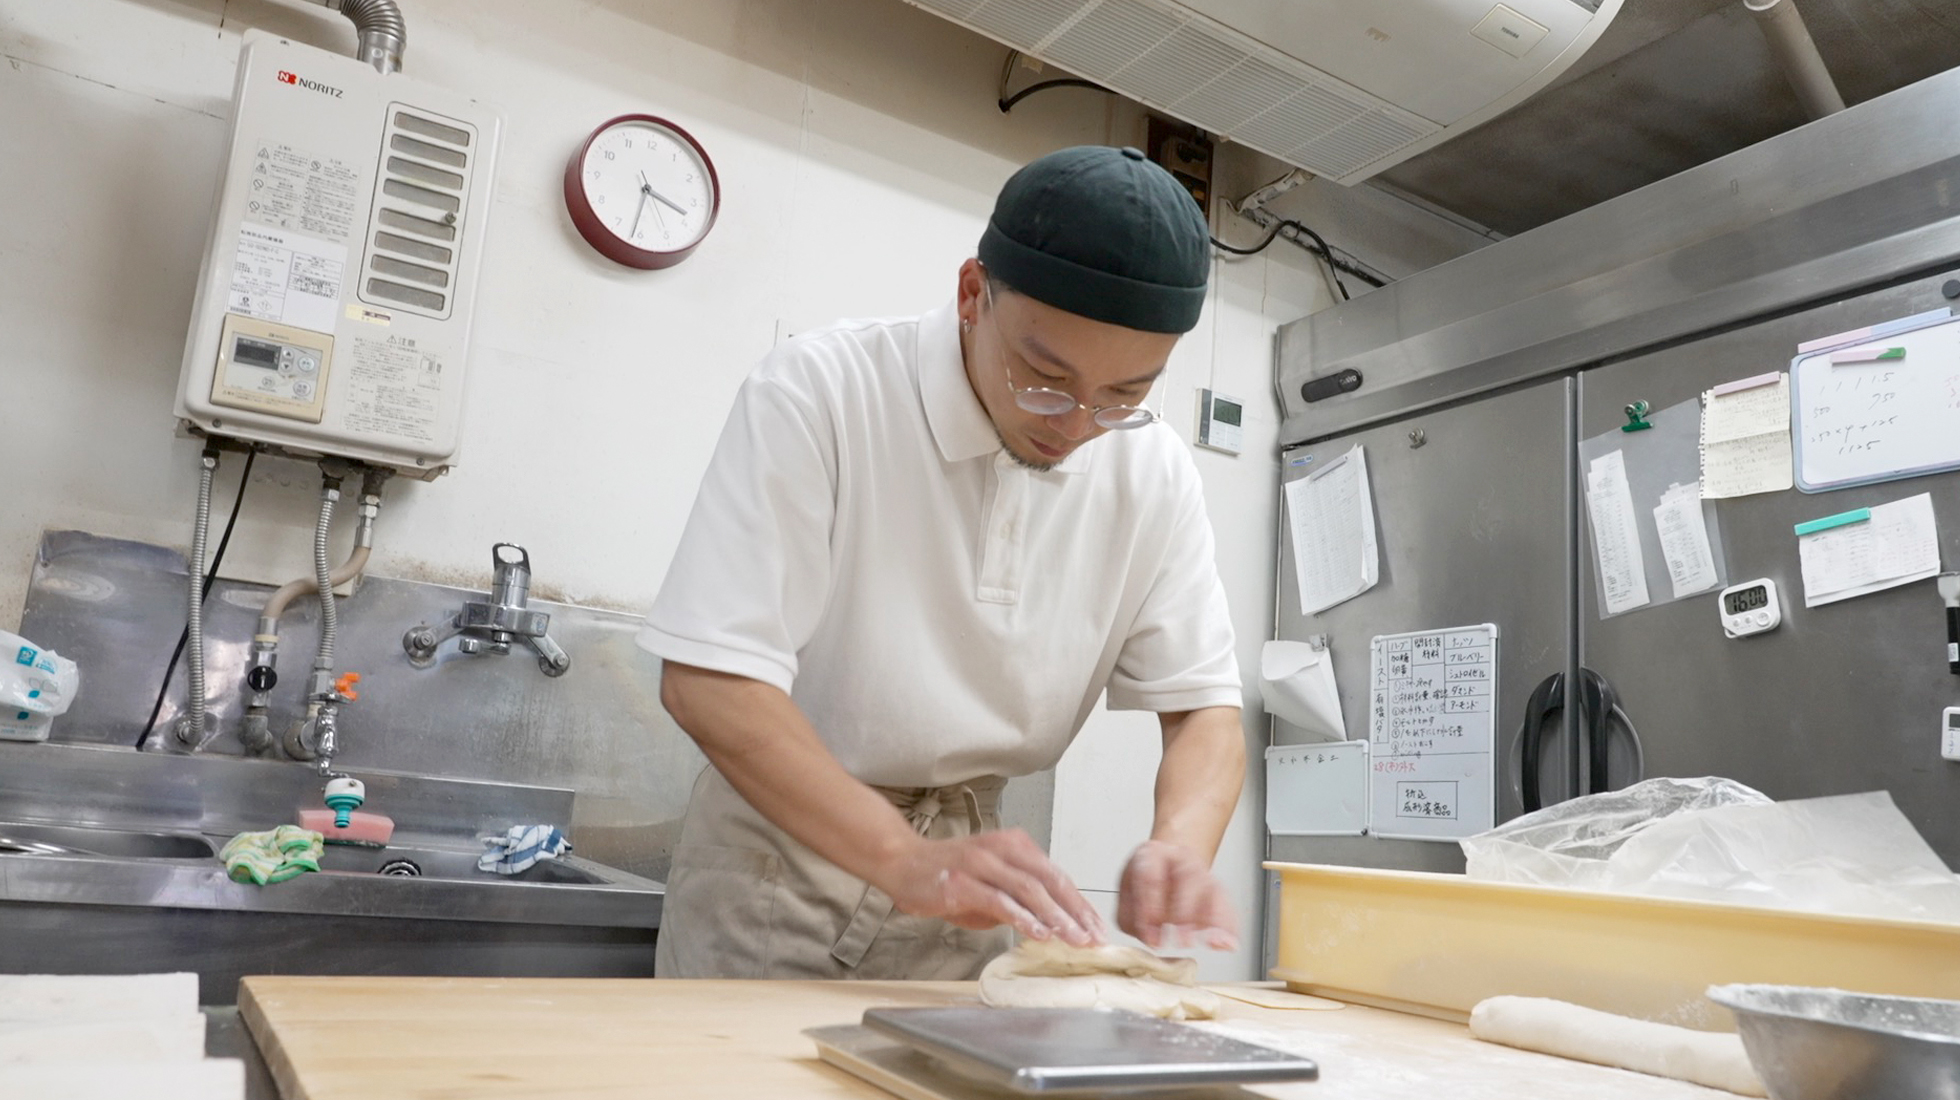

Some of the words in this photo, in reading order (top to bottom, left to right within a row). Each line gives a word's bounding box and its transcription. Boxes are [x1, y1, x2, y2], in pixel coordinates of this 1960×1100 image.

[299, 77, 343, 99] NORITZ
[625, 138, 632, 149] 11
[647, 140, 658, 151] 12
[604, 150, 615, 161] 10
[672, 153, 677, 162] 1
[593, 170, 601, 180] 9
[686, 173, 693, 183] 2
[598, 195, 605, 205] 8
[691, 198, 697, 208] 3
[614, 216, 622, 226] 7
[637, 230, 644, 239] 6
[663, 230, 670, 240] 5
